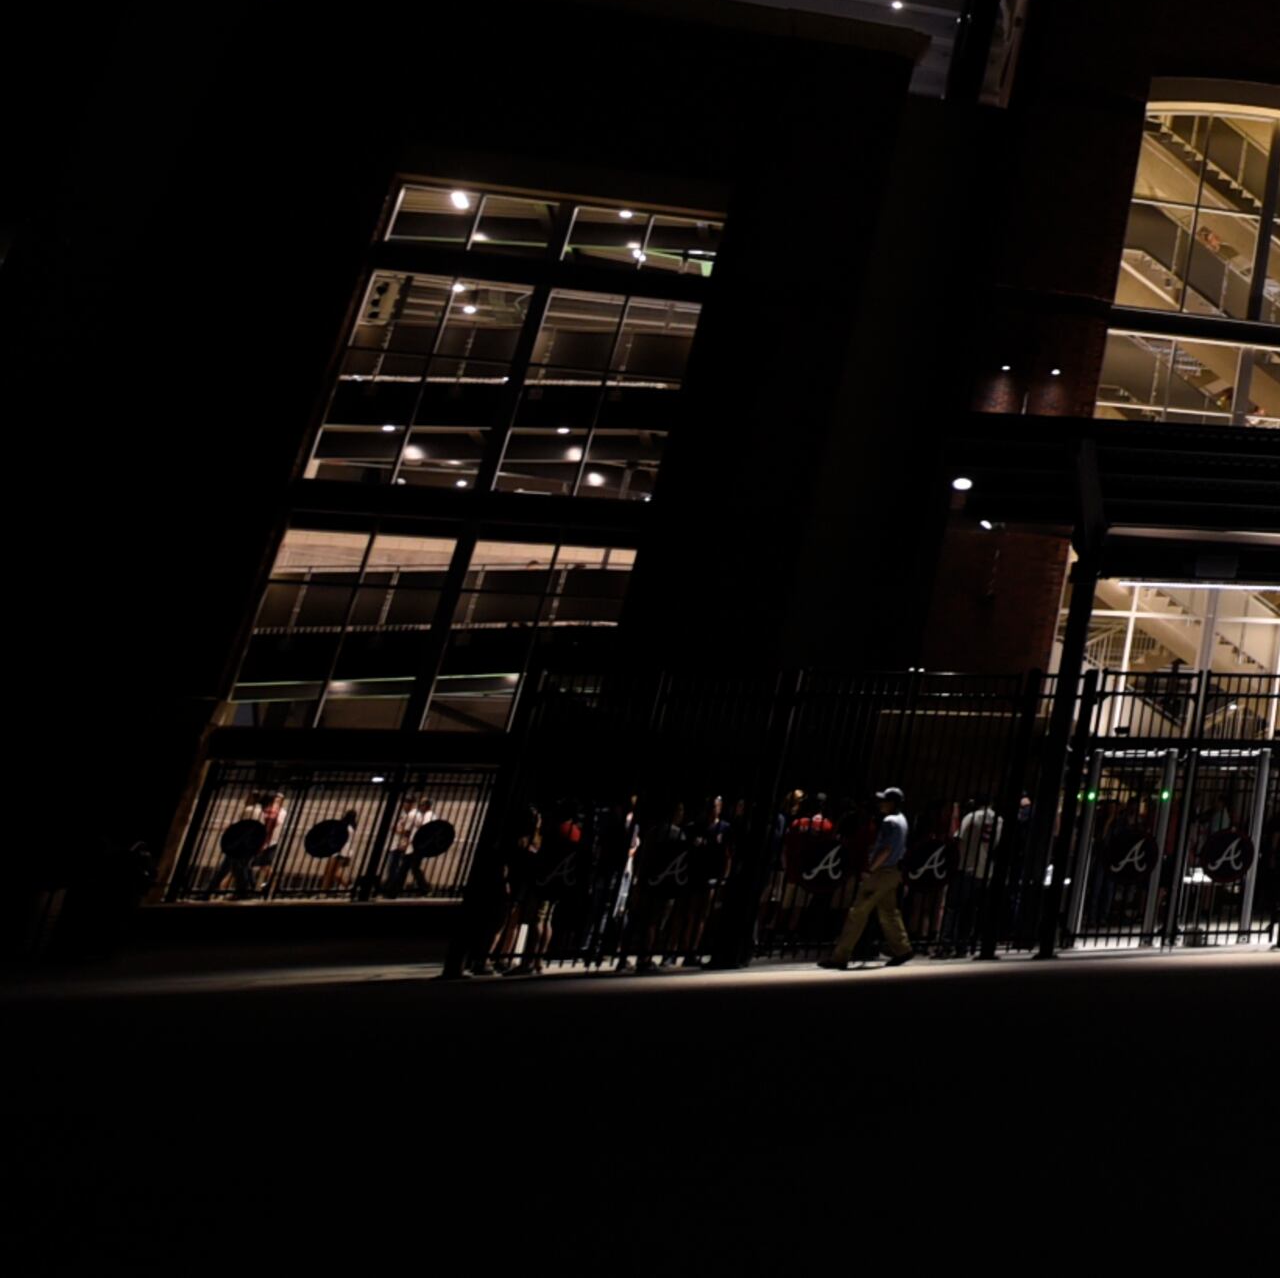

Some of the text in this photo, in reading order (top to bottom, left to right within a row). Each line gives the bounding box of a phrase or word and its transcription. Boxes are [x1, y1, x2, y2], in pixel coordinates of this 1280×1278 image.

[802, 845, 843, 881] A
[908, 843, 947, 880] A
[1110, 837, 1147, 873] A
[1208, 837, 1243, 871] A
